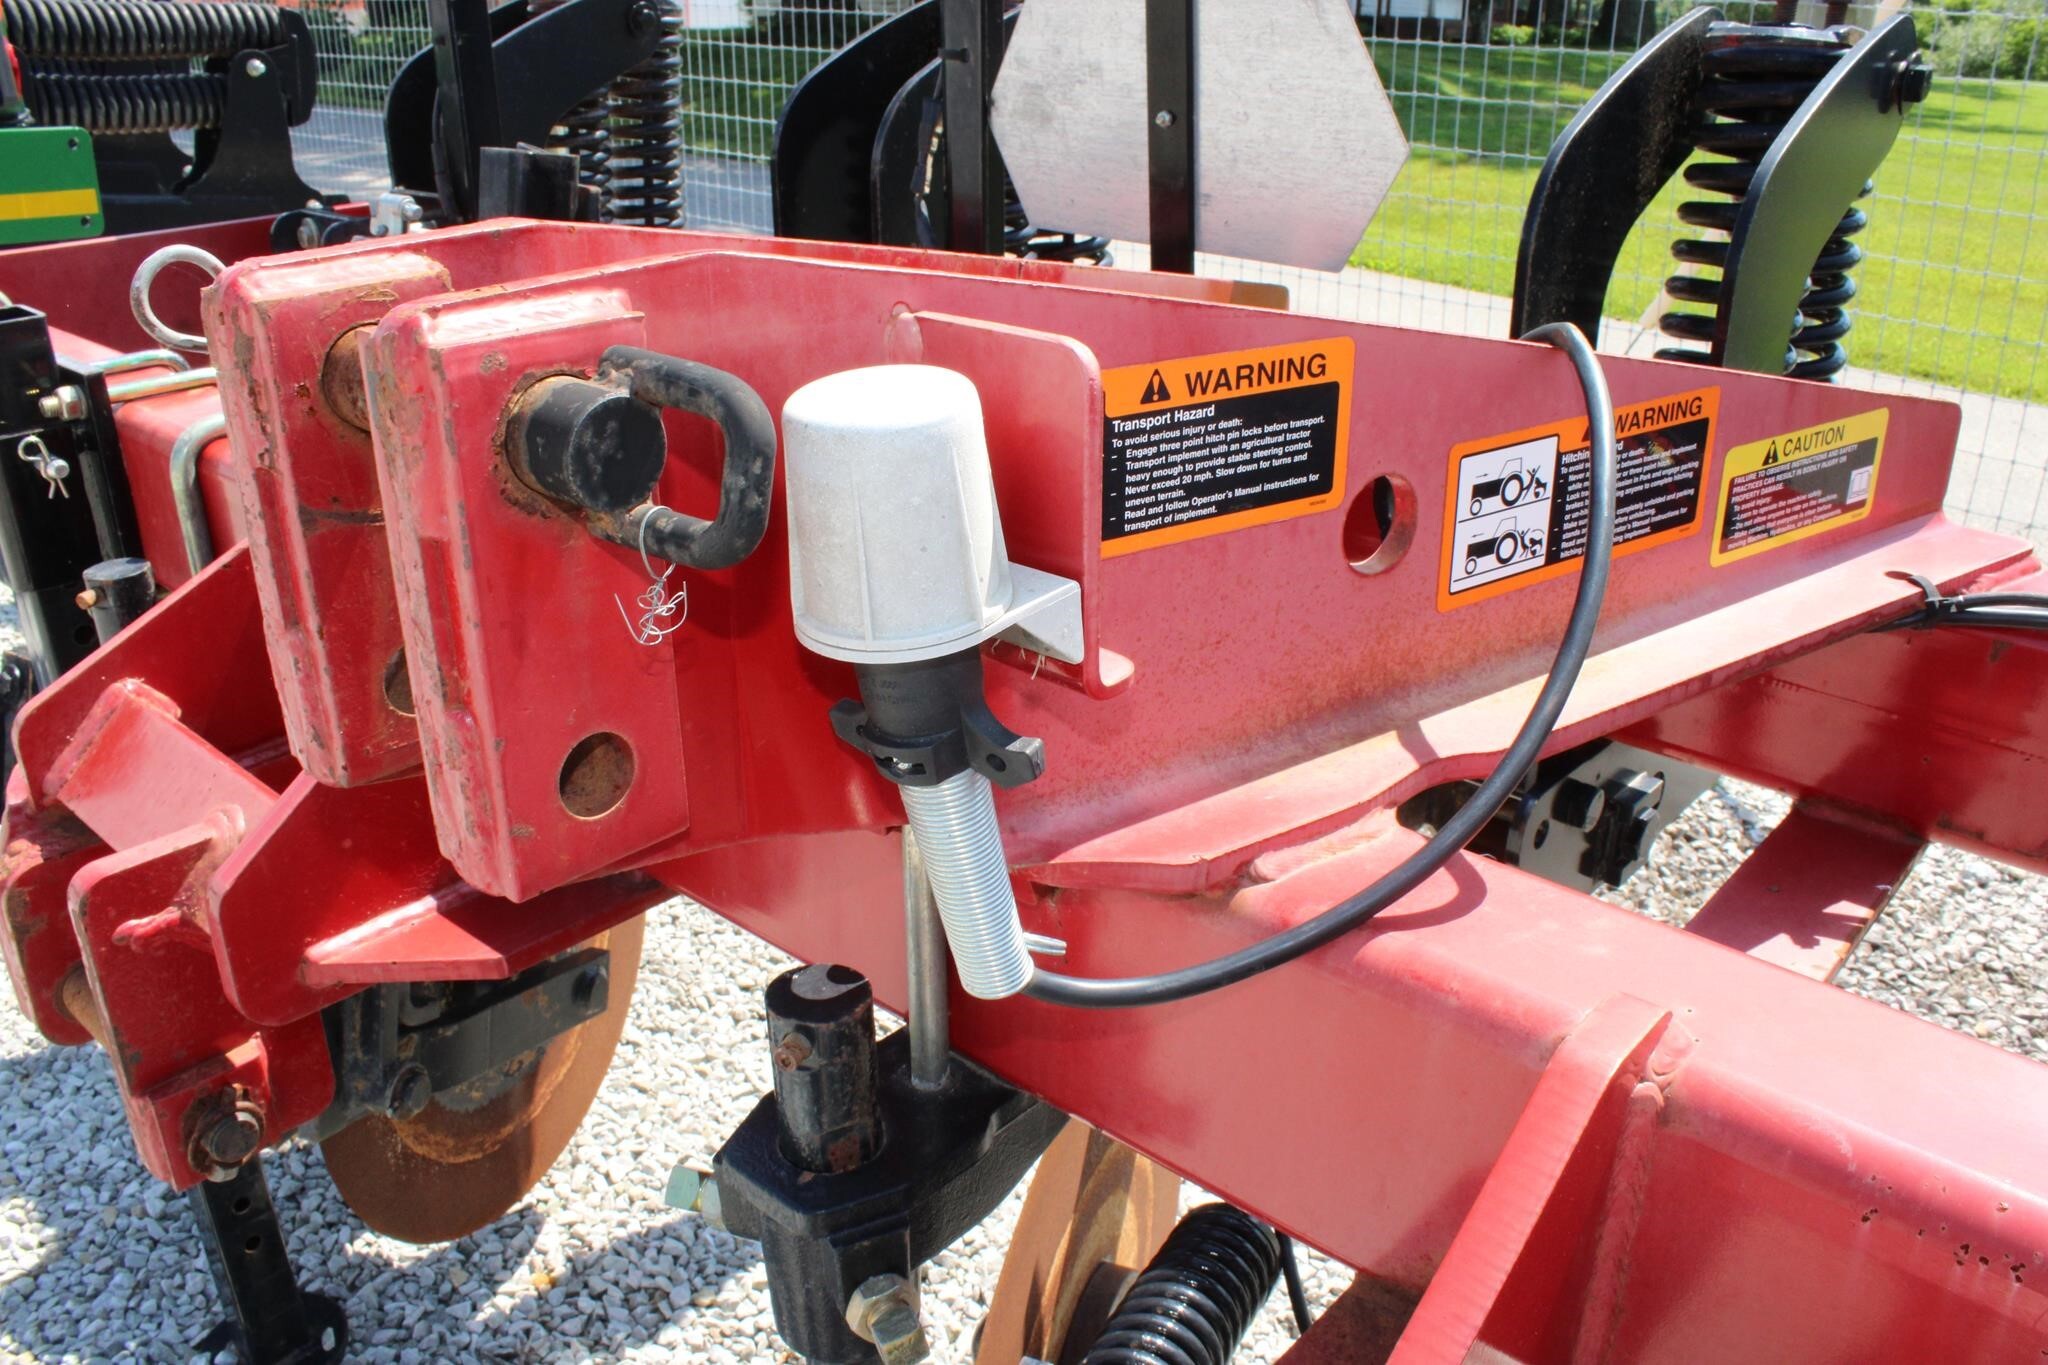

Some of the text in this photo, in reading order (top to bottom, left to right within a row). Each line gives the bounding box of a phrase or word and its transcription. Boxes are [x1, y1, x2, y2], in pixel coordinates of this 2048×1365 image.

[1185, 353, 1327, 397] WARNING
[1112, 405, 1215, 433] Transport Hazard
[1112, 439, 1122, 448] To
[1125, 434, 1148, 445] avoid
[1150, 429, 1180, 440] serious
[1183, 425, 1205, 436] injury
[1218, 419, 1242, 428] death:
[1126, 415, 1325, 458] Engage three point hitch pin locks before transport.
[1126, 430, 1311, 470] Transport implement with an agricultural tractor
[1783, 425, 1845, 457] CAUTION
[1126, 440, 1312, 483] heavy enough to provide stable steering control.
[1561, 466, 1568, 474] To
[1562, 450, 1590, 464] Hitchin
[1125, 452, 1307, 495] Never exceed 20 mph. Slow down for turns and
[1125, 473, 1319, 520] Read and follow Operator's Manual instructions for
[1125, 489, 1186, 507] uneven terrain.
[1125, 517, 1162, 532] transport
[1175, 506, 1217, 521] implement.
